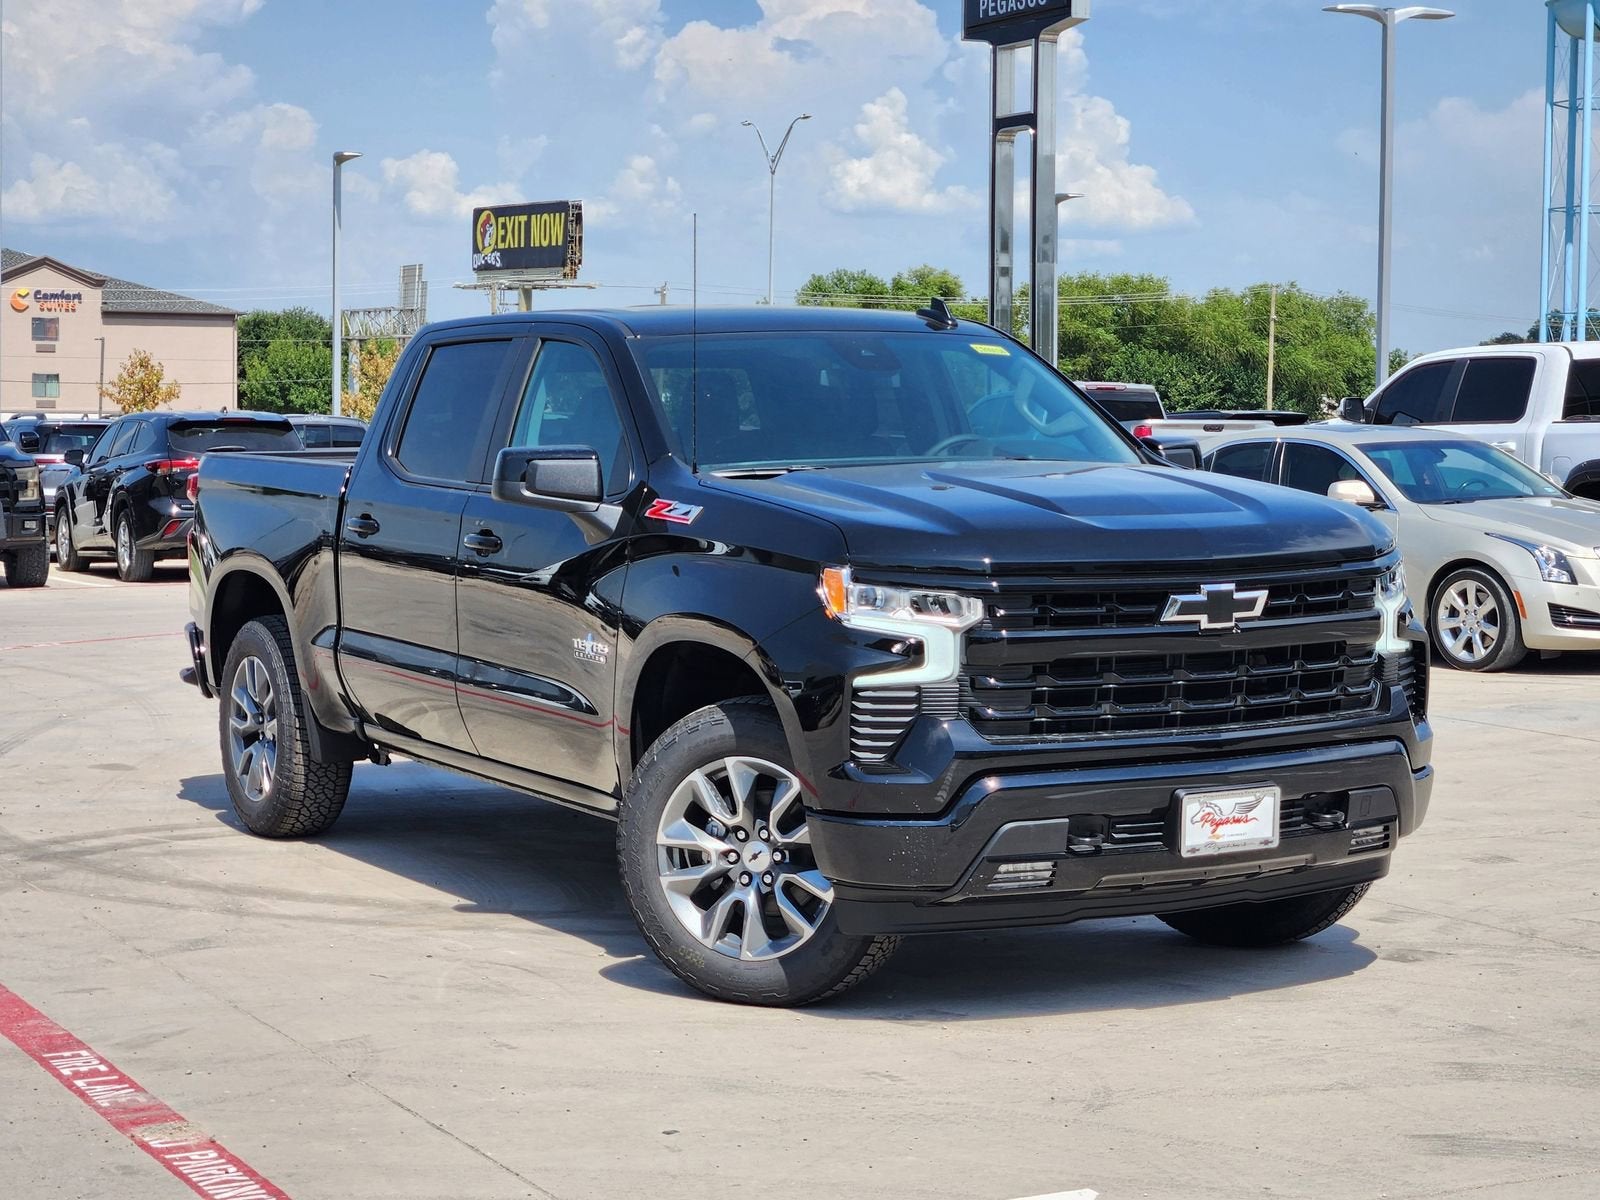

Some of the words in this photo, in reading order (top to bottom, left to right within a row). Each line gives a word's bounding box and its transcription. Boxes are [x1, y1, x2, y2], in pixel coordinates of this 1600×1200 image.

[979, 0, 1047, 18] PEGAS
[497, 215, 527, 249] EXIT
[531, 212, 565, 247] NOW
[33, 290, 82, 304] Comfort
[39, 303, 77, 312] SUITES
[1201, 812, 1258, 834] Pegasus
[42, 1050, 109, 1076] FIRE
[164, 1150, 277, 1200] PARKIN
